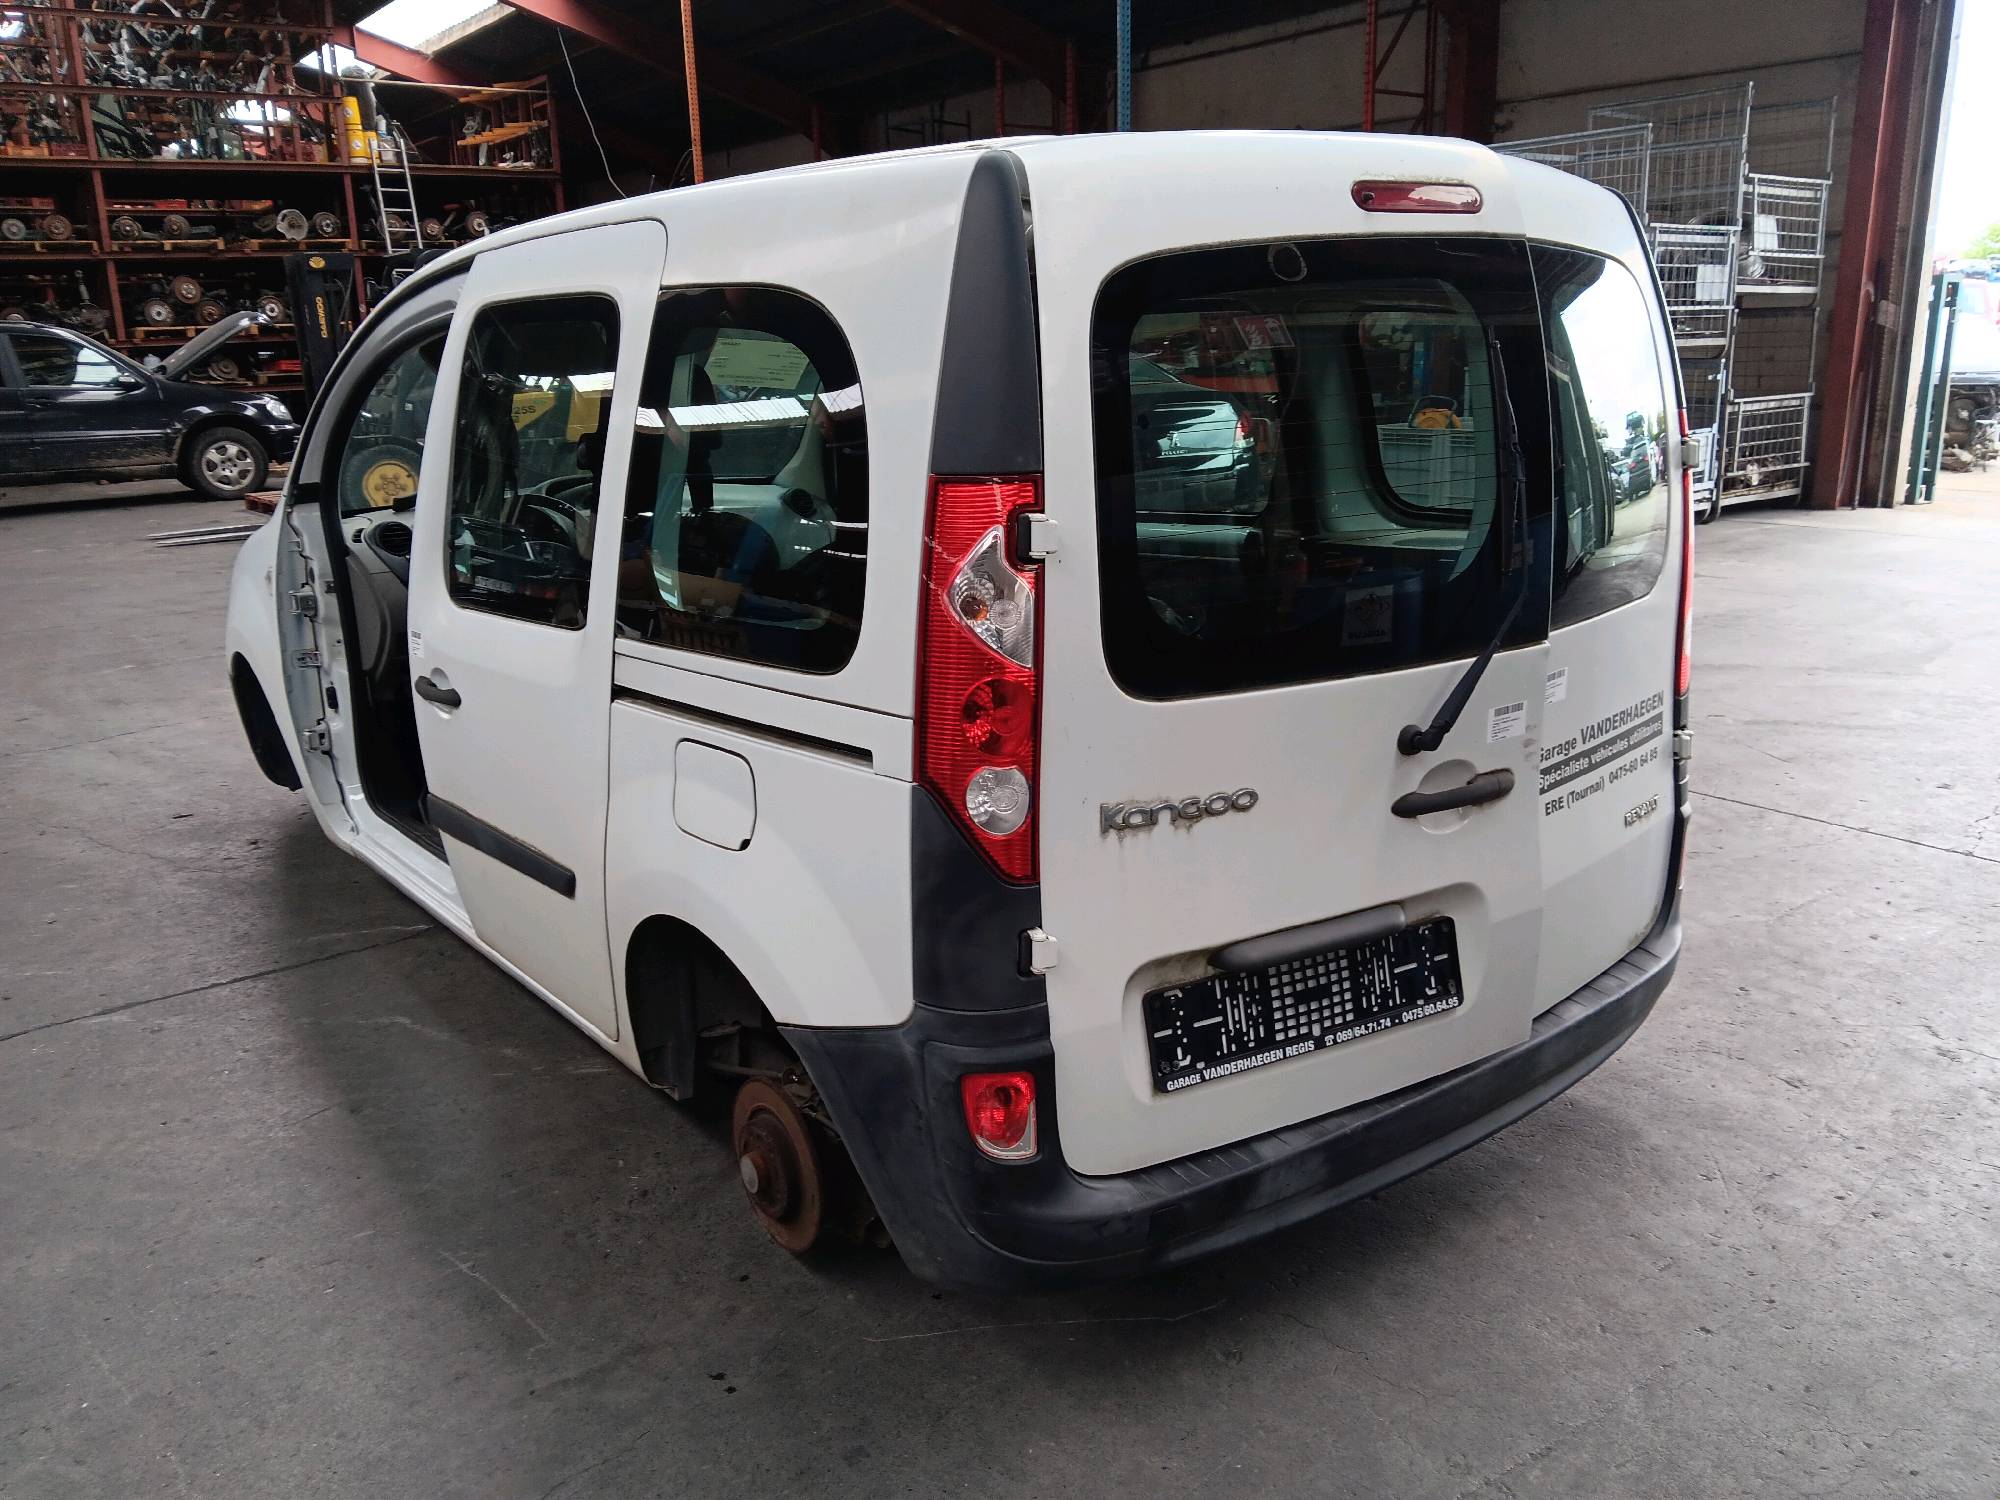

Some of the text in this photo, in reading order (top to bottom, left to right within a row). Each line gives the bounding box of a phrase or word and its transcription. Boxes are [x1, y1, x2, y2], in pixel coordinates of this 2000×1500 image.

[1580, 690, 1664, 745] VANDERHAEGEN
[1545, 796, 1565, 817] ERE
[1166, 1073, 1202, 1091] GARAGE
[1203, 1049, 1284, 1081] VANDERHAEGEN
[1285, 1040, 1316, 1058] REGIS
